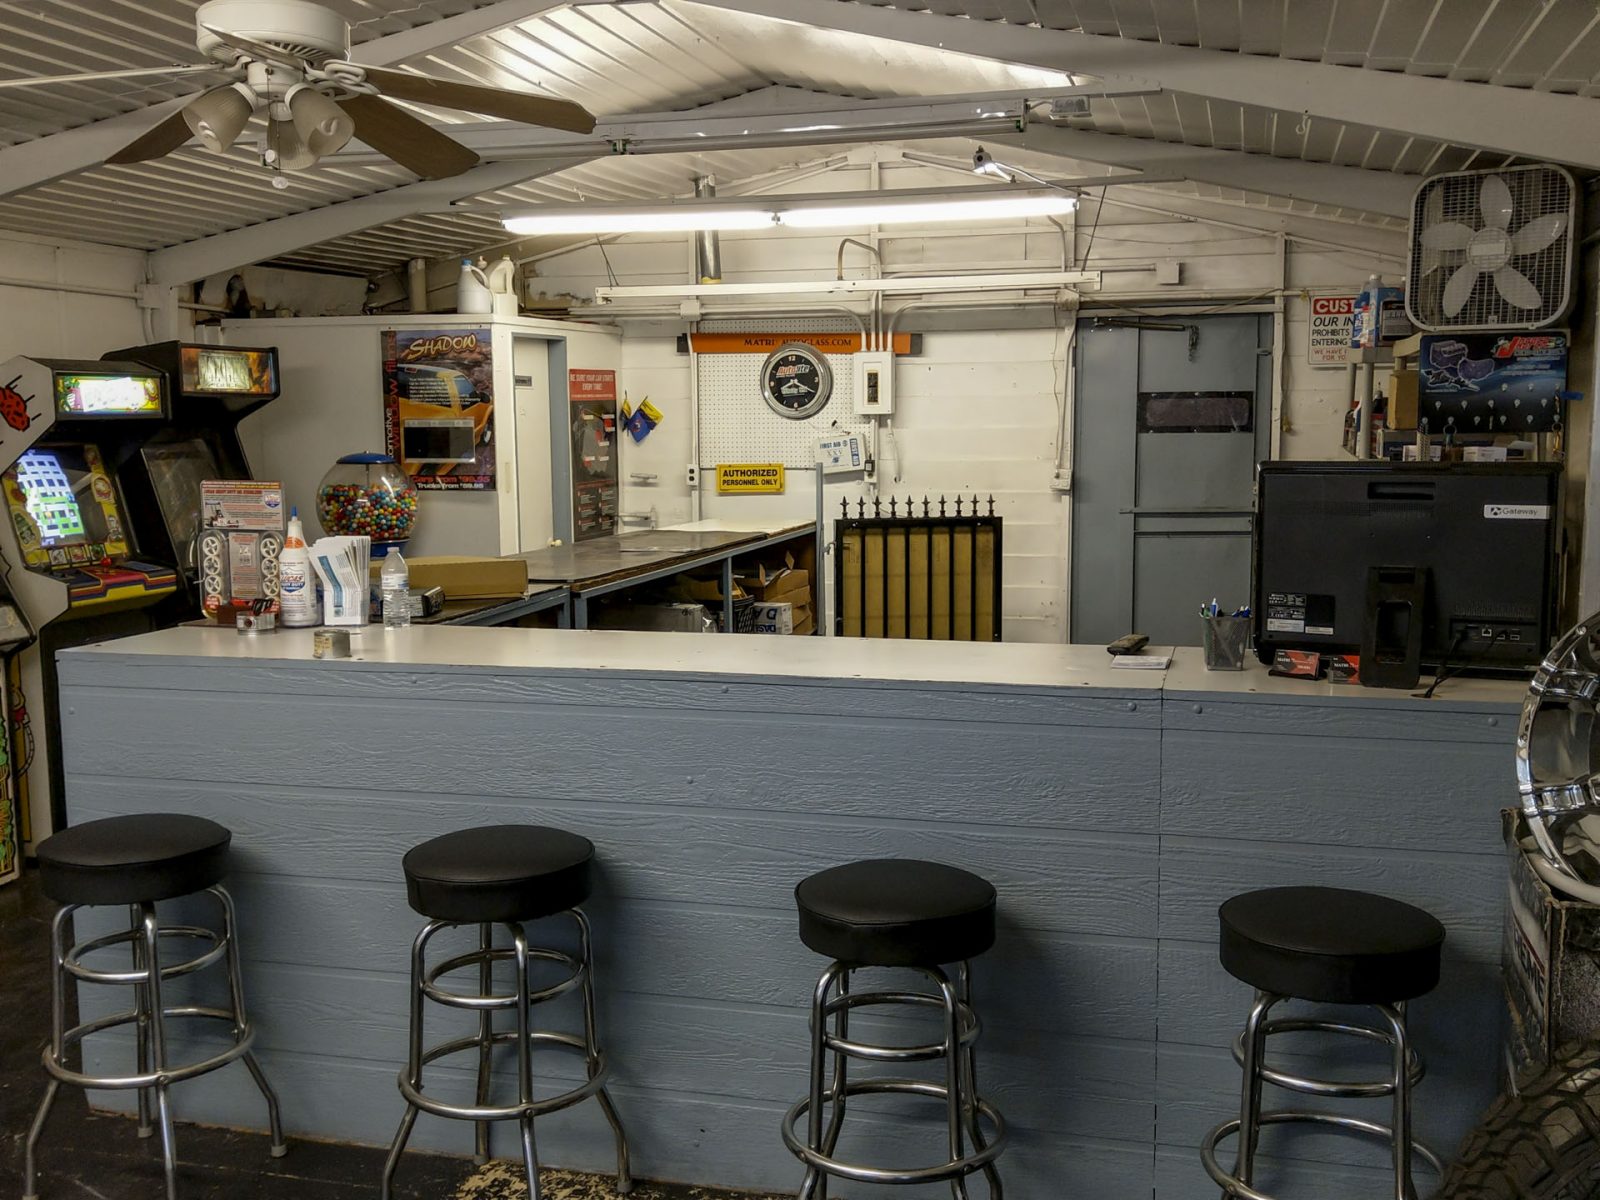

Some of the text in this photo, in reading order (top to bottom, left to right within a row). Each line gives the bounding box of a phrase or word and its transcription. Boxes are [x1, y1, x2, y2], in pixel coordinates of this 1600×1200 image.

[1313, 316, 1339, 328] OUR
[1312, 328, 1350, 337] PROHIBITS
[405, 333, 477, 361] SHADOW
[1312, 338, 1348, 347] ENTERING
[723, 469, 778, 477] AUTHORIZED
[1502, 507, 1538, 516] Gateway
